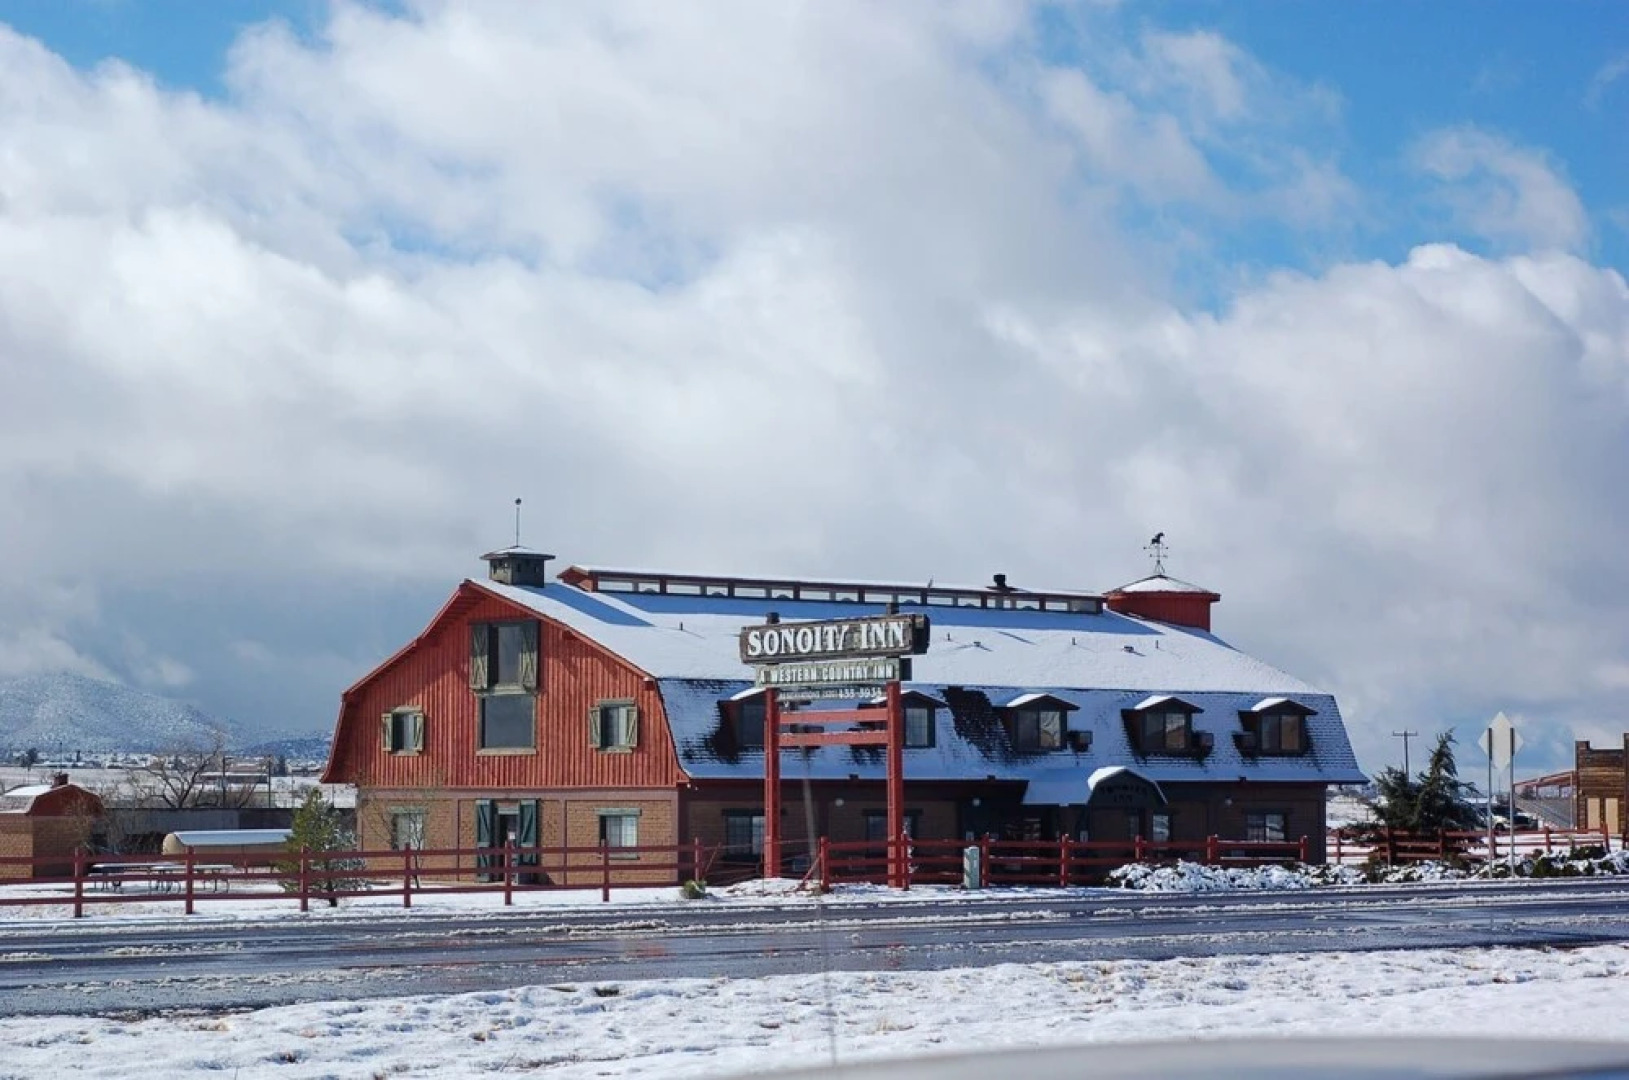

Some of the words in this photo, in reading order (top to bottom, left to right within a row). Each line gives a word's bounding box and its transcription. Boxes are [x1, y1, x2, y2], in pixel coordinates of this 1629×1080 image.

[860, 621, 905, 649] INN
[770, 668, 817, 683] WESTERN
[822, 665, 868, 680] COUNTRY
[873, 663, 894, 679] INN
